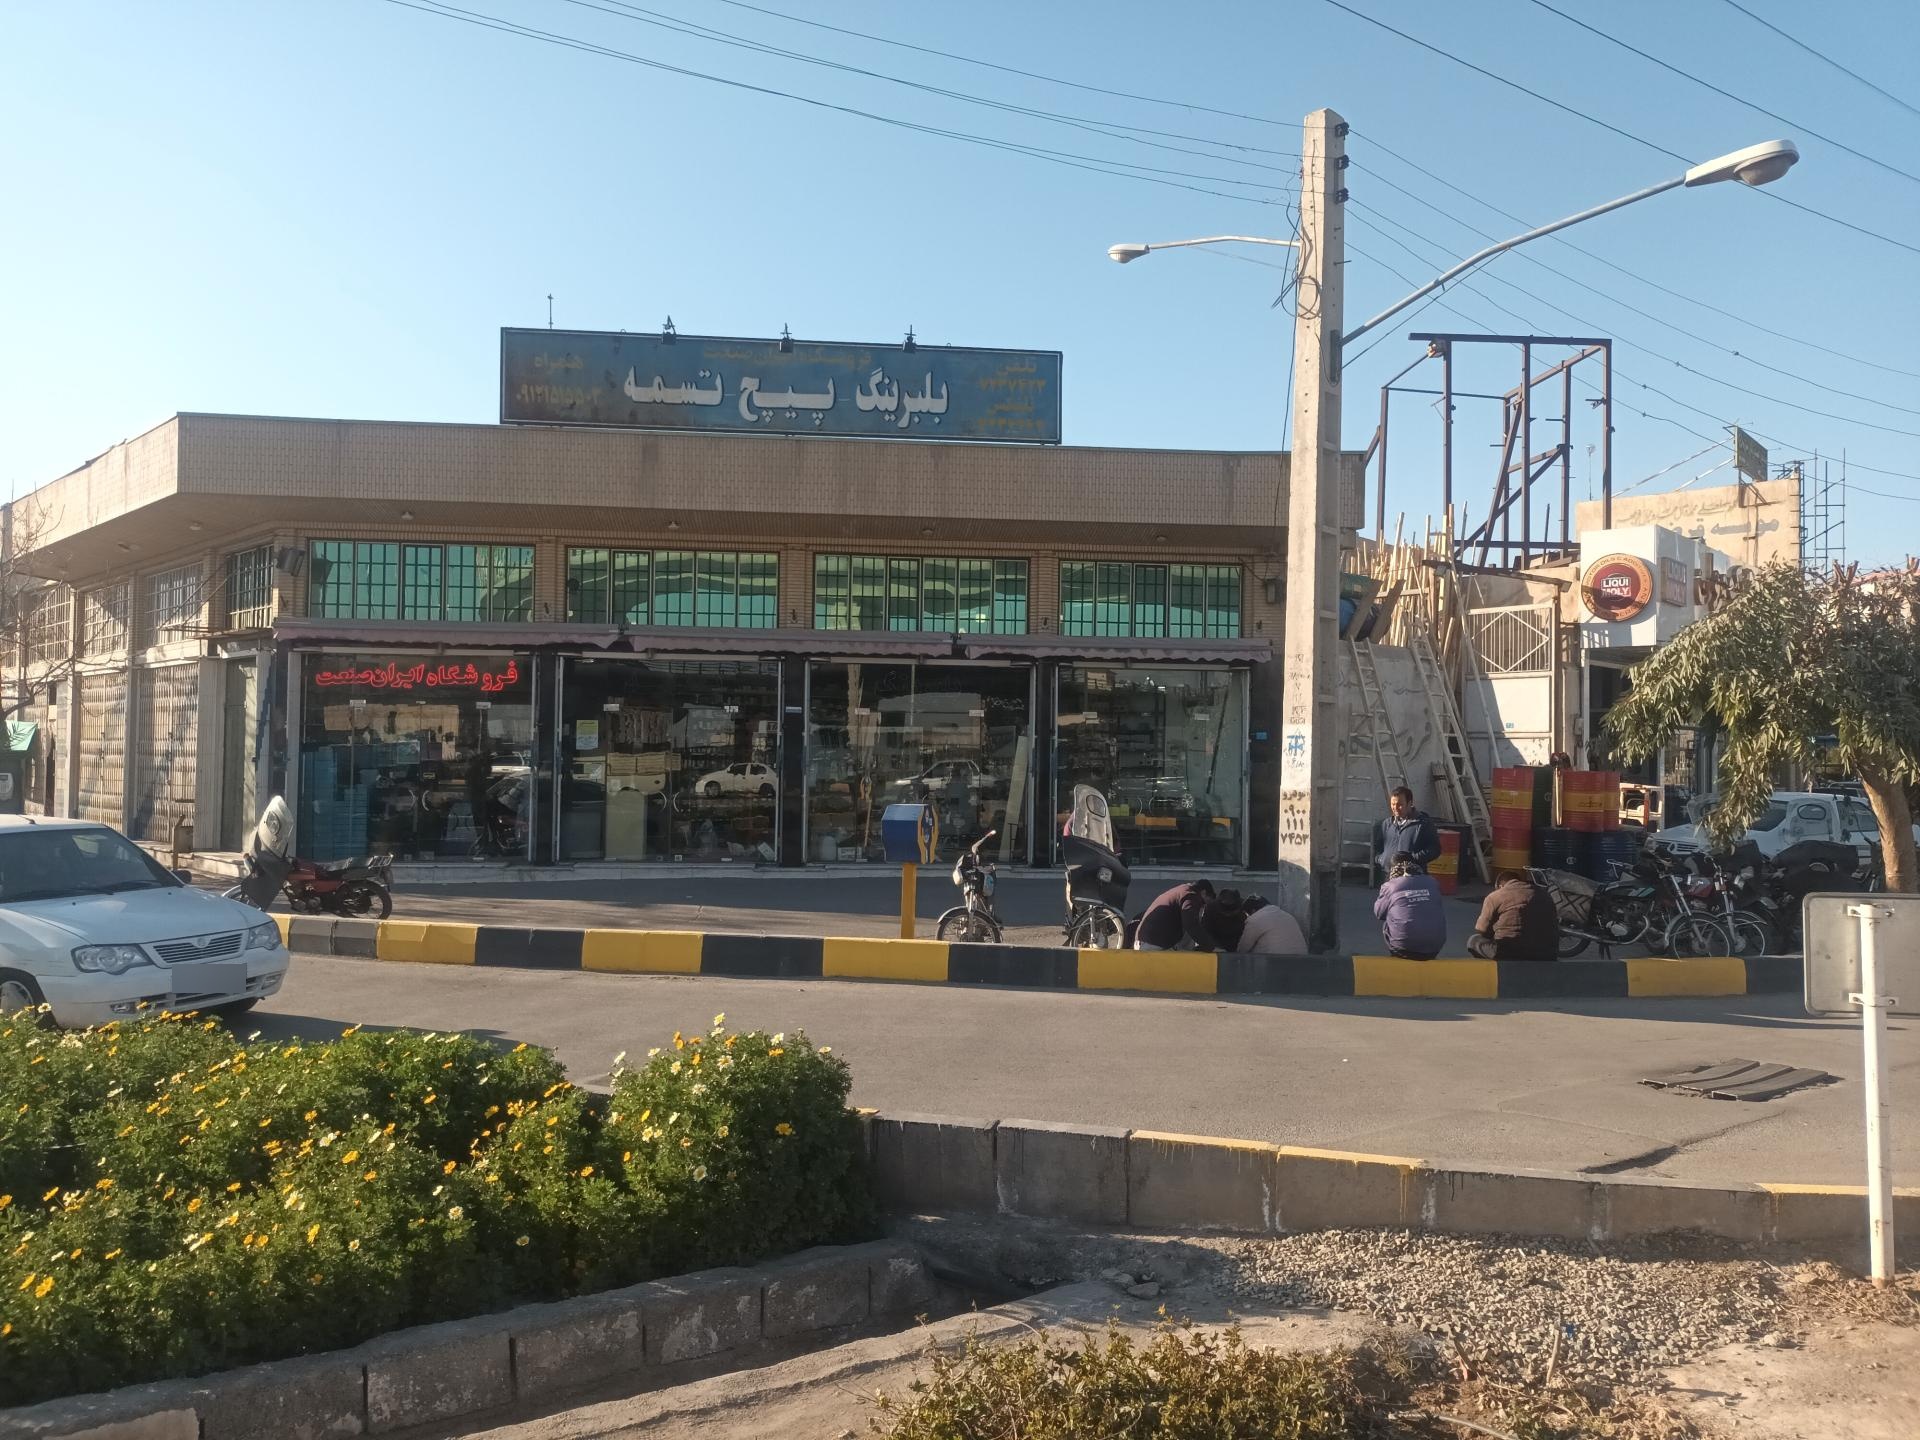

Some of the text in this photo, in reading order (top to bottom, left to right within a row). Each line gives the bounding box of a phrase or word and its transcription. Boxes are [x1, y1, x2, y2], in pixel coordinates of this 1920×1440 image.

[624, 365, 949, 428] بلبرینگ پیچ تسمه
[1603, 578, 1629, 588] LIQUI
[1602, 587, 1630, 597] MOLY
[315, 660, 518, 691] فروشگاه ایران صنعت
[1284, 804, 1306, 817] ۰۹۰۰
[1286, 817, 1304, 831] ۱۱۱
